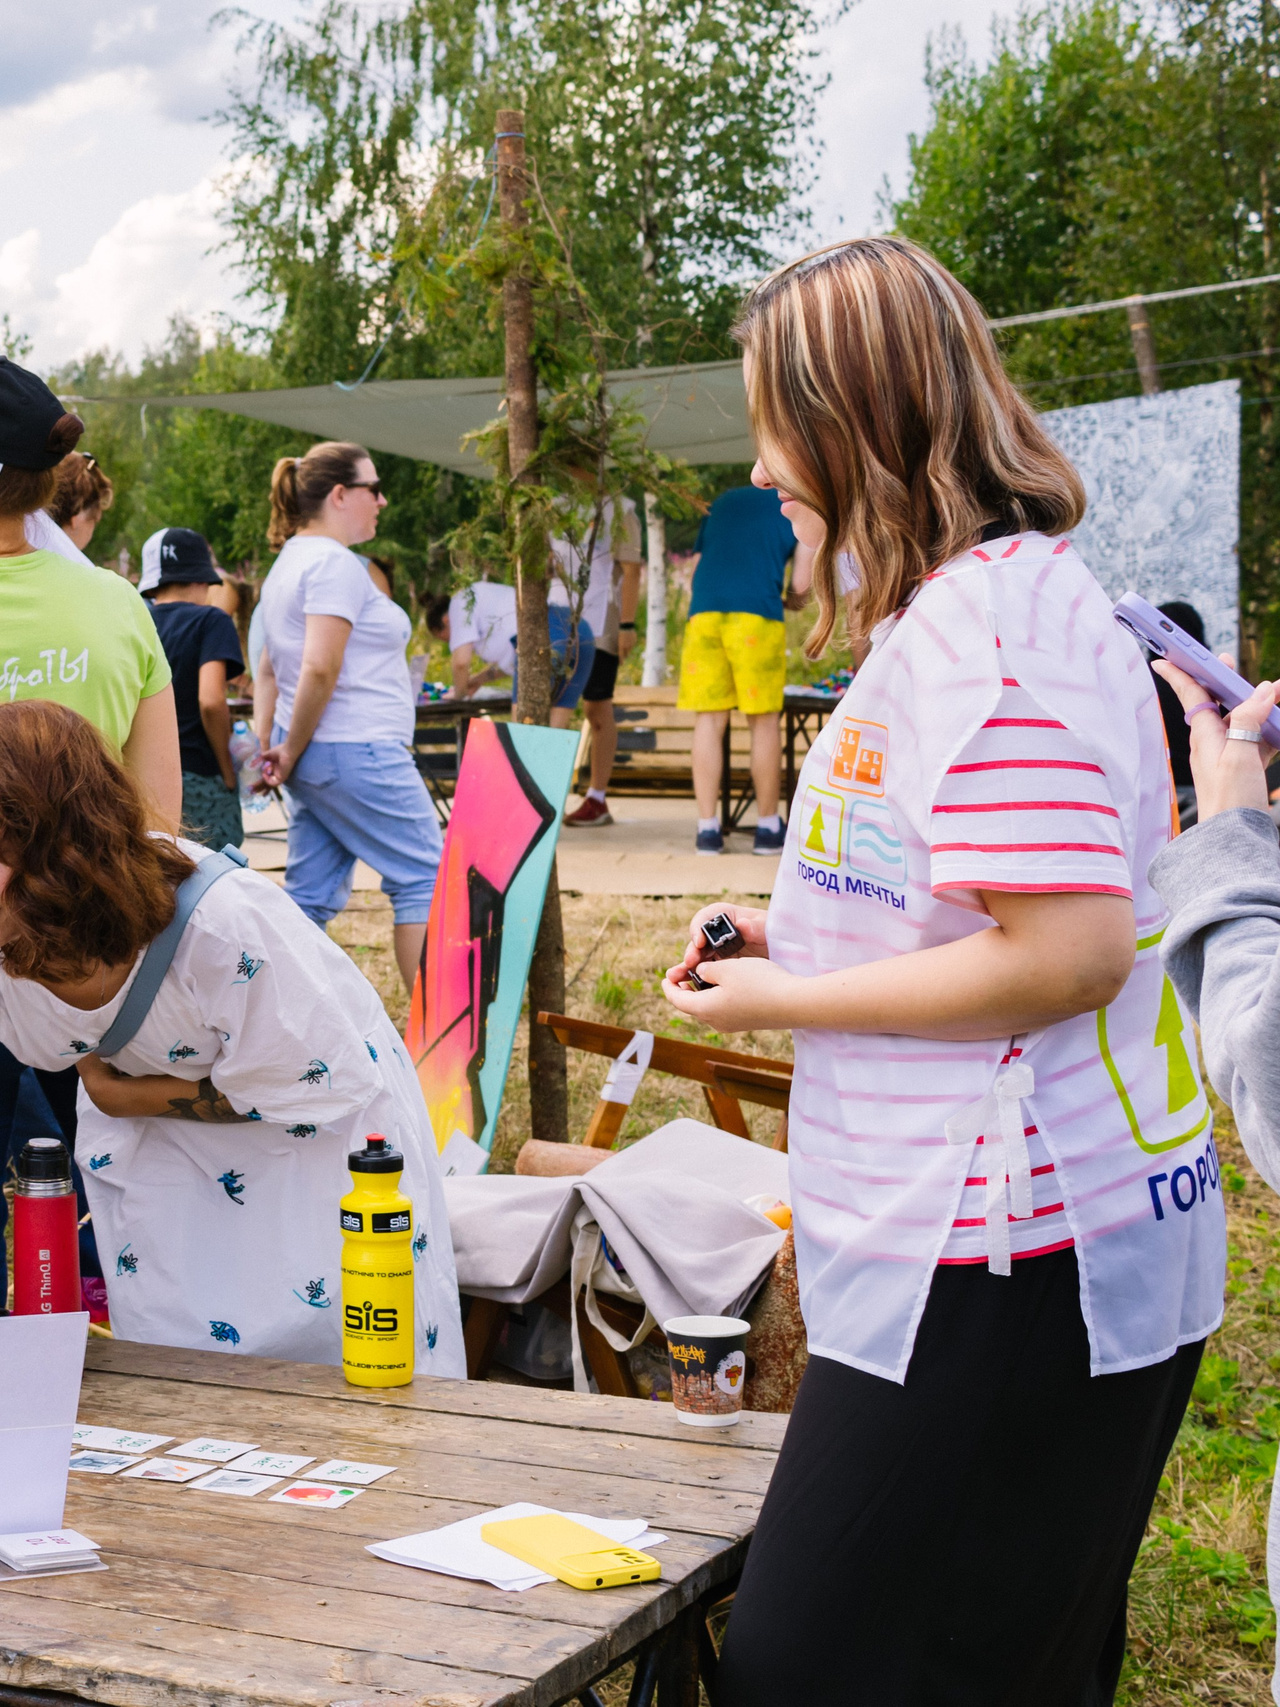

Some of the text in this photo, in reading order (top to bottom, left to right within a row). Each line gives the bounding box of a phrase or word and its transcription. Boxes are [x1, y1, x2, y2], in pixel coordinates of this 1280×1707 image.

[797, 860, 906, 911] ГОРОД МЕЧТЫ
[1147, 1133, 1222, 1221] ГОРО
[39, 1262, 52, 1298] ThinQ
[347, 1269, 375, 1278] NOTHING
[40, 1302, 53, 1314] G
[345, 1300, 398, 1332] SiS
